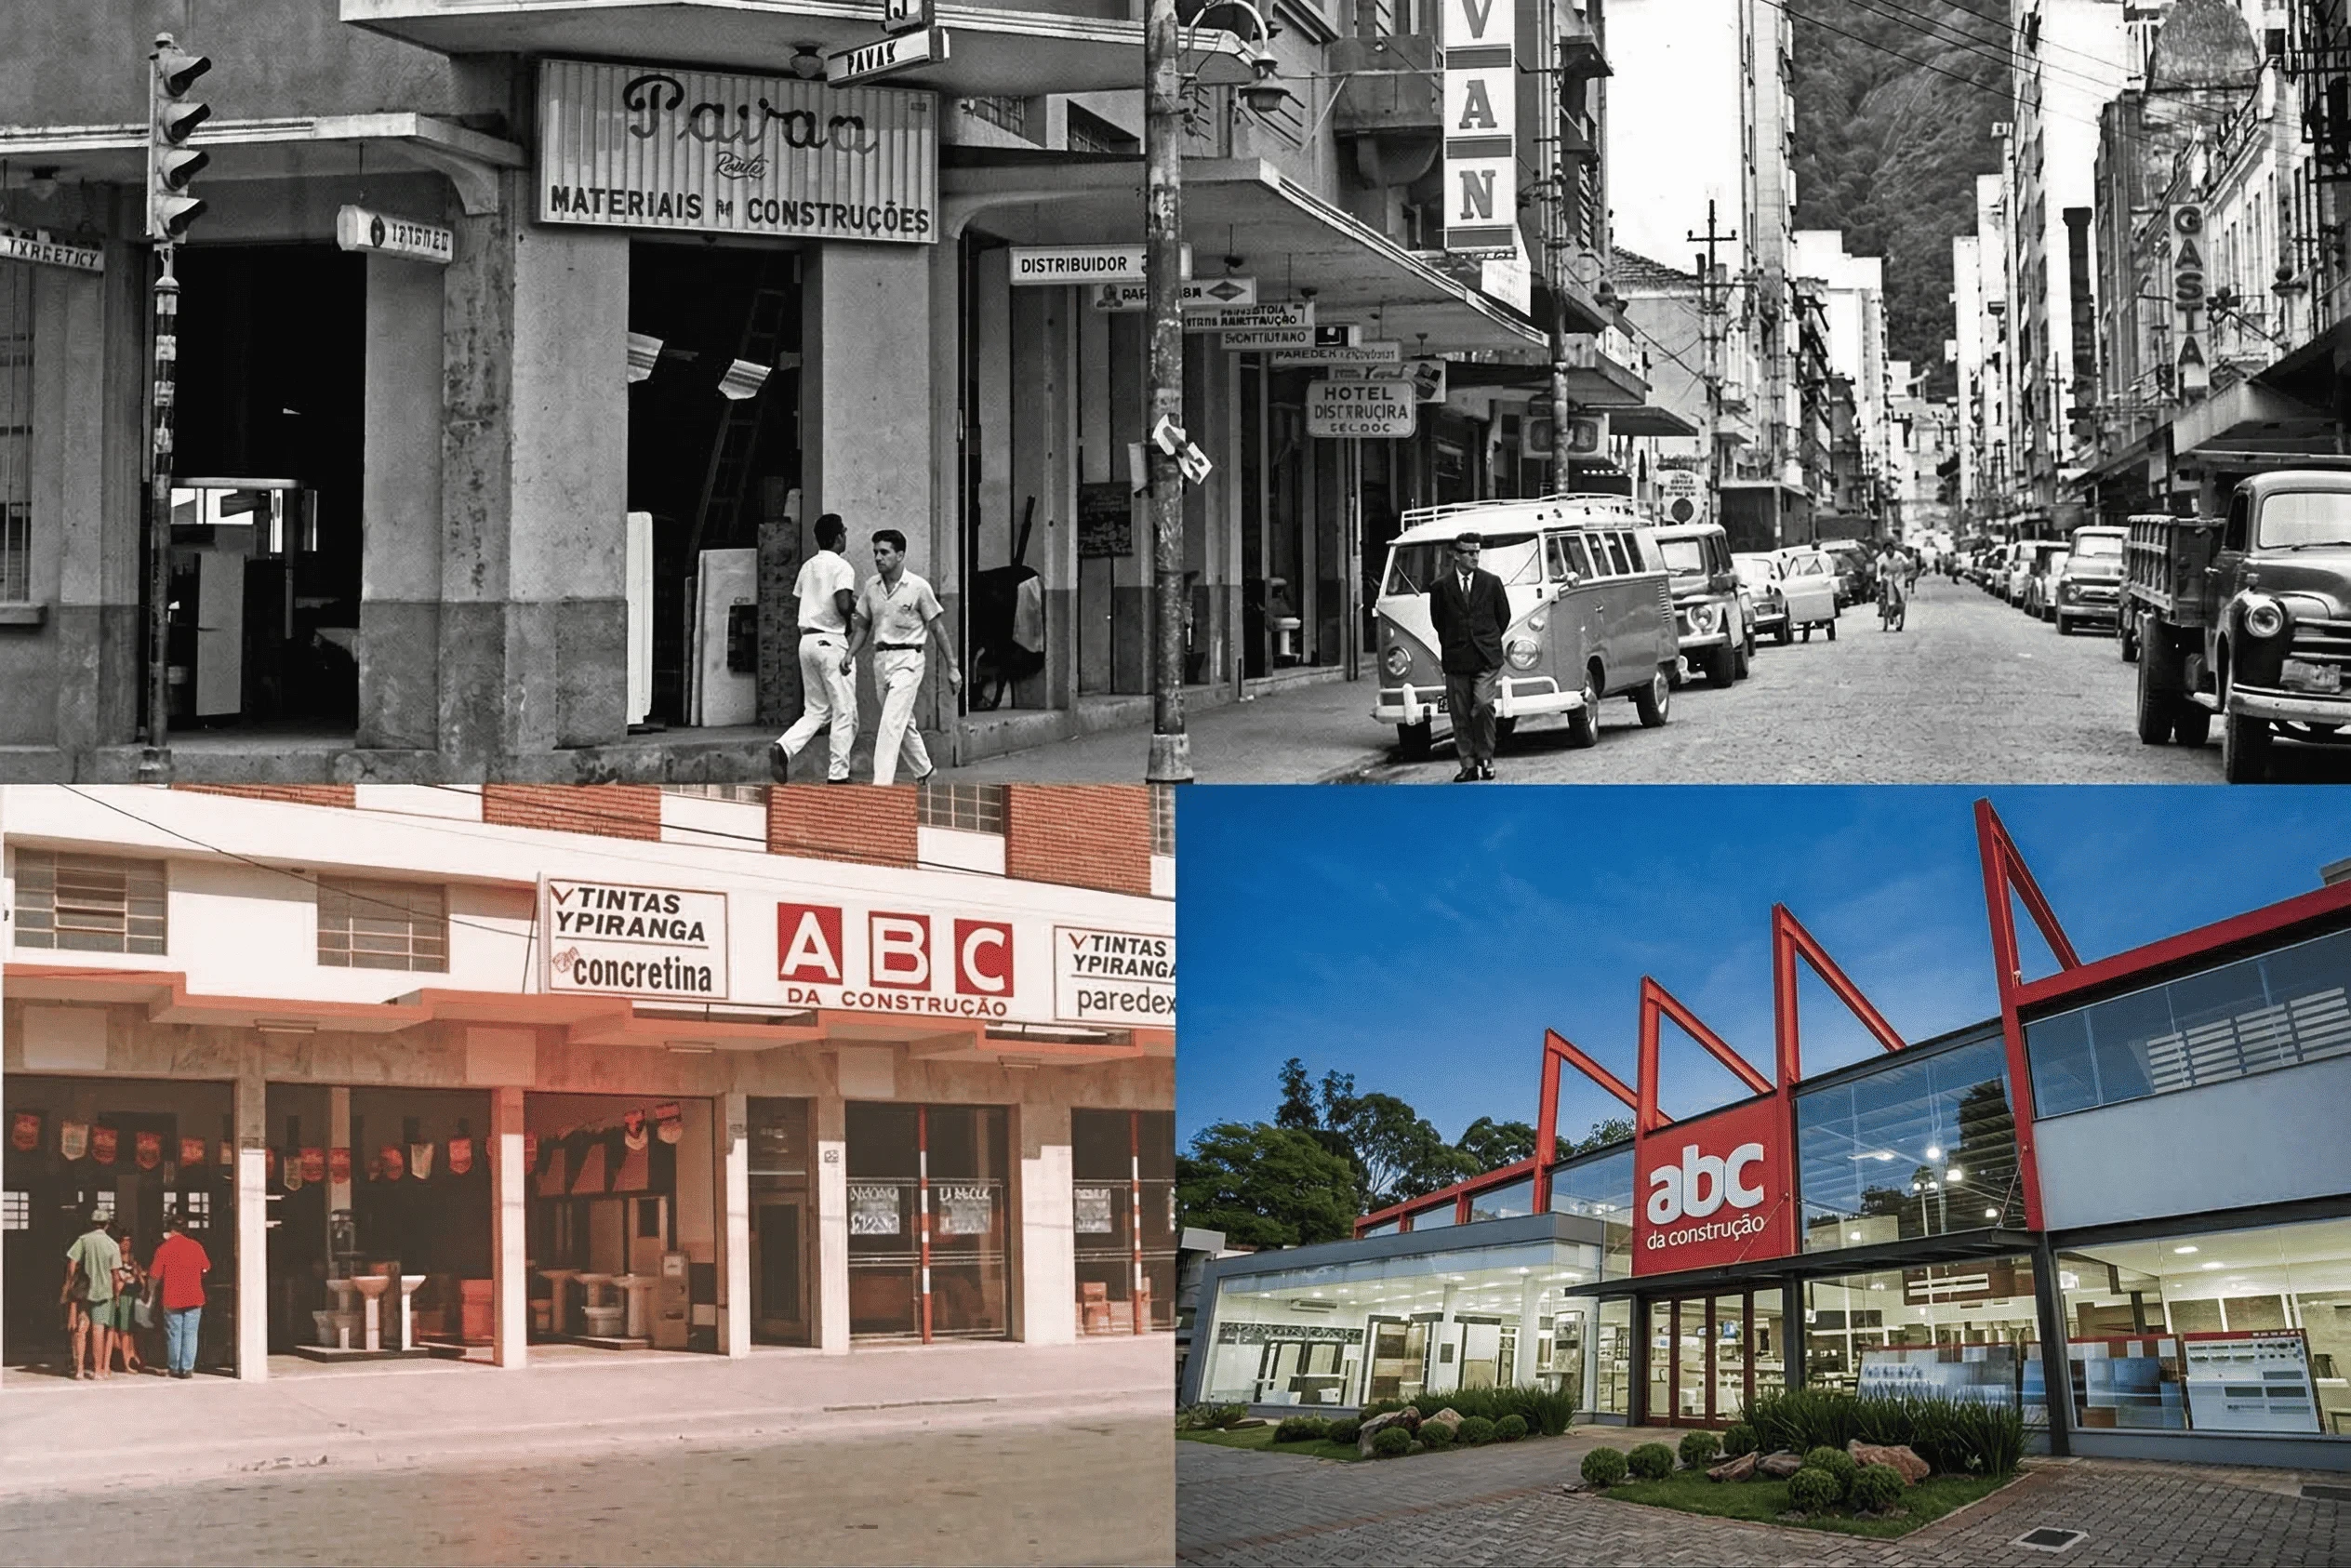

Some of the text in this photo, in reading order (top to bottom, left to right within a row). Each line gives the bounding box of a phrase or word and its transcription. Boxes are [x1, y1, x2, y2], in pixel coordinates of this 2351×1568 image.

[551, 185, 701, 219] MATERIAIS
[748, 197, 929, 235] CONSTRUÇÕES
[1021, 256, 1127, 273] DISTRIBUIDOR
[1324, 386, 1394, 401] HOTEL
[578, 887, 681, 915] TINTAS
[556, 911, 705, 941] YPIRANGA
[1090, 934, 1166, 958] TINTAS
[573, 955, 711, 992] concretina
[787, 988, 1007, 1017] DA CONSTRUÇÃO
[1647, 1142, 1764, 1225] abc
[1647, 1214, 1764, 1250] da construção
